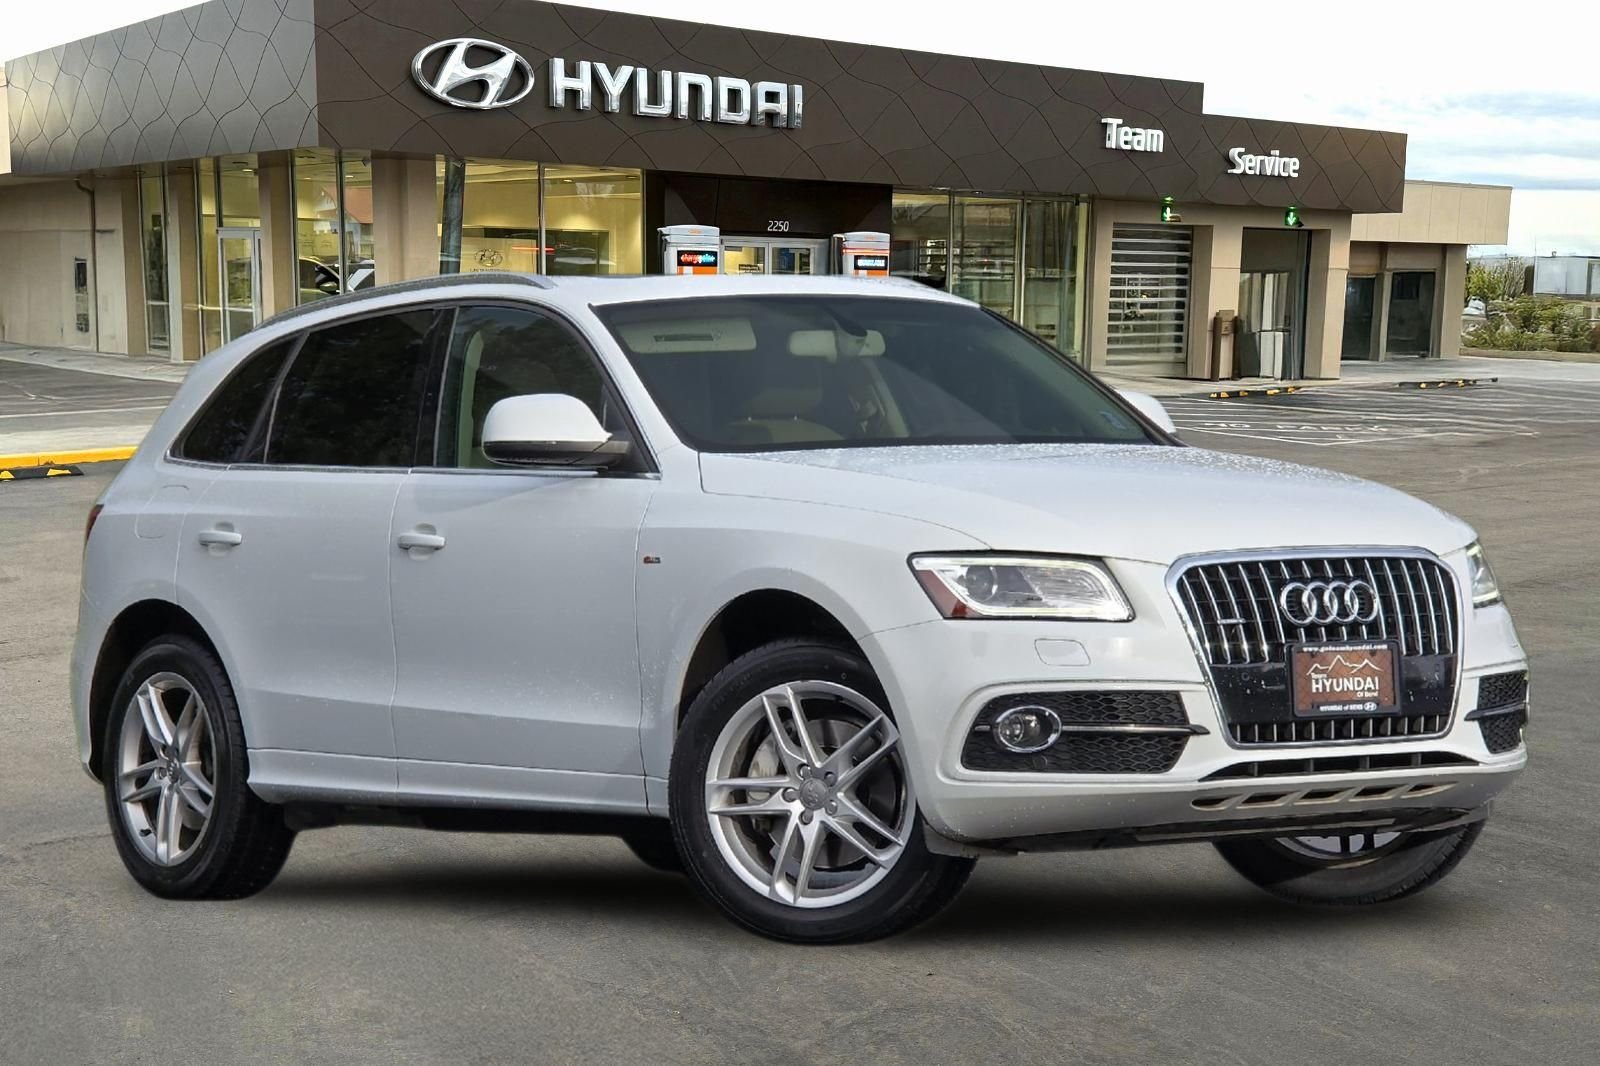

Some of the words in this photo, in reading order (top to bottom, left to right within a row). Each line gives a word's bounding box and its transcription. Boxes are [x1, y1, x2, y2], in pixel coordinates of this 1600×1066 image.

[548, 57, 803, 129] HYUNDAI
[1101, 117, 1164, 153] Team
[1227, 147, 1300, 178] Service
[767, 220, 790, 232] 2250
[1311, 676, 1379, 693] HYUNDAI
